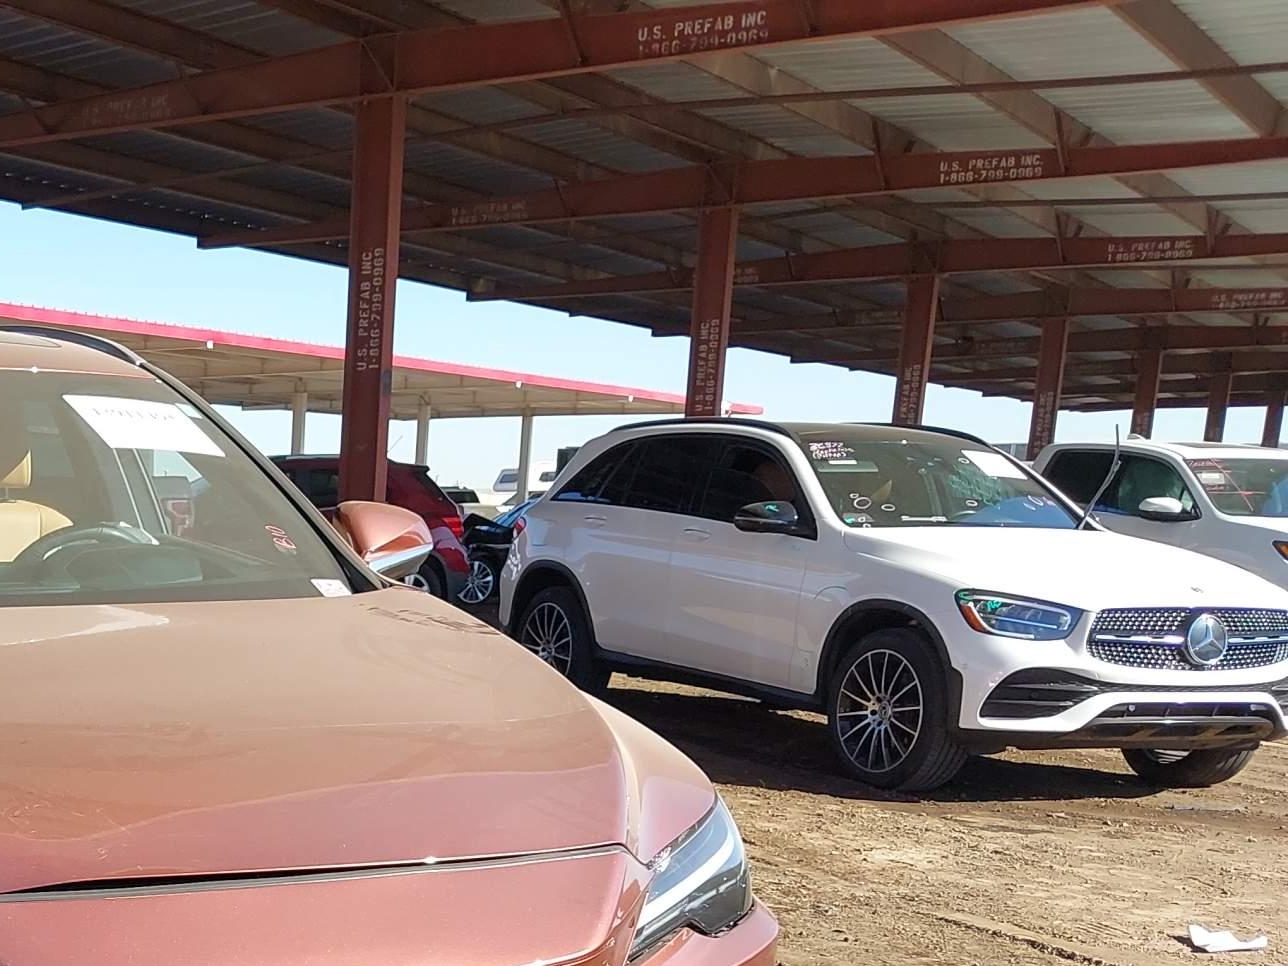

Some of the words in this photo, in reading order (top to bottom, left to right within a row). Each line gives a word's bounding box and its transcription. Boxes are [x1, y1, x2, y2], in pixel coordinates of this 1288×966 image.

[638, 25, 666, 42] U.S.
[674, 15, 734, 37] PREFAB
[939, 161, 963, 172] U.S.
[968, 156, 1016, 170] PREFAB
[1021, 154, 1044, 167] INC.
[939, 167, 1043, 184] 1-866-799-0969
[358, 281, 371, 337] PREFAB
[368, 247, 385, 369] 1-866-799-0969
[356, 344, 369, 371] U.S.
[696, 344, 708, 386] PREFAB
